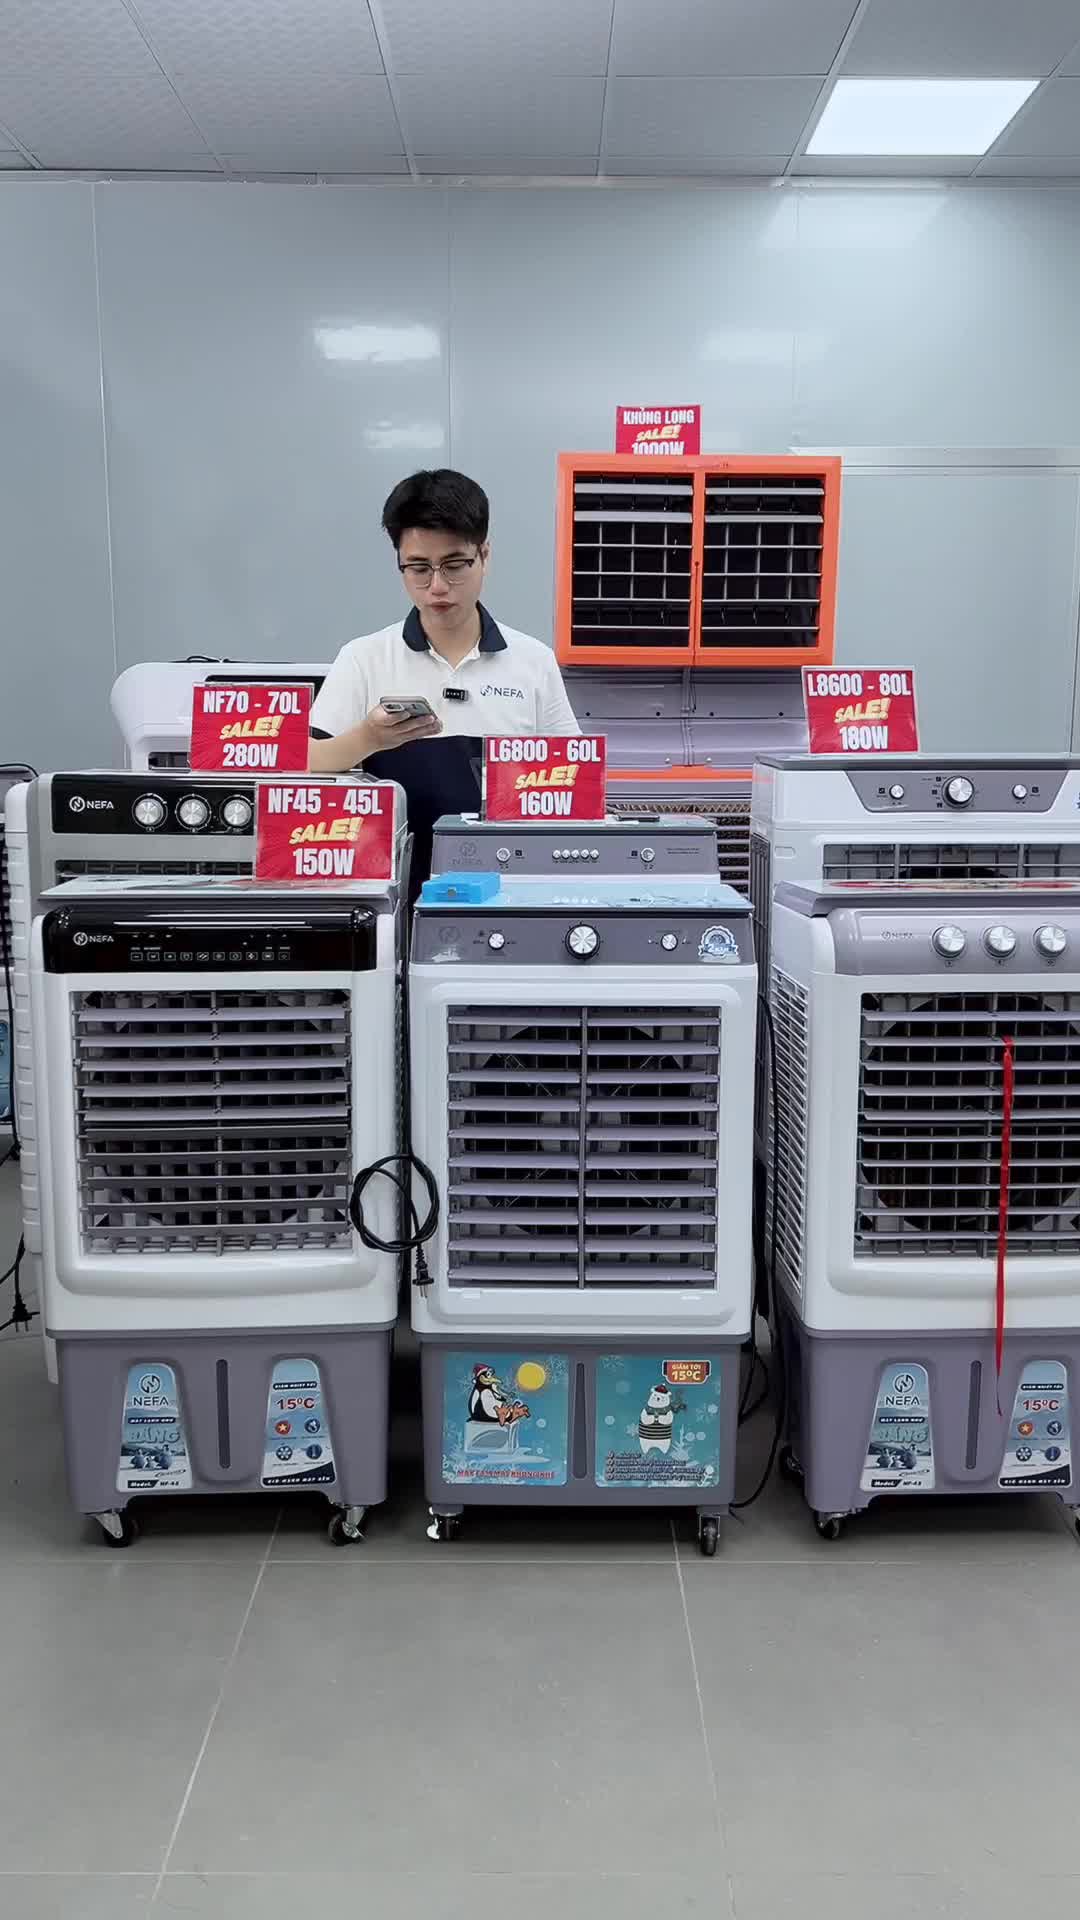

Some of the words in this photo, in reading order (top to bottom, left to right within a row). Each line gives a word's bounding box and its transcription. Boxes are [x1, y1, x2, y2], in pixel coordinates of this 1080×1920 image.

[623, 407, 661, 424] KHỦNG
[665, 409, 695, 424] LONG
[635, 424, 682, 441] SALE!
[631, 440, 685, 455] 1000W
[493, 687, 524, 699] NEFA
[807, 672, 863, 696] L8600
[879, 672, 911, 696] 80L
[203, 690, 249, 713] NF70
[268, 691, 302, 714] 70L
[833, 697, 891, 723] SALE!
[219, 715, 284, 740] SALE!
[839, 725, 889, 750] 180W
[222, 743, 279, 767] 280W
[489, 739, 548, 762] L6800
[566, 739, 601, 762] 60L
[514, 764, 580, 790] SALE!
[86, 801, 114, 809] NEFA
[268, 788, 321, 814] NF45
[343, 789, 383, 815] 45L
[518, 791, 573, 816] 160W
[289, 817, 364, 845] SALE!
[293, 848, 355, 876] 150W
[89, 935, 114, 943] NEFA
[133, 1396, 169, 1406] NEFA
[885, 1396, 920, 1406] NEFA
